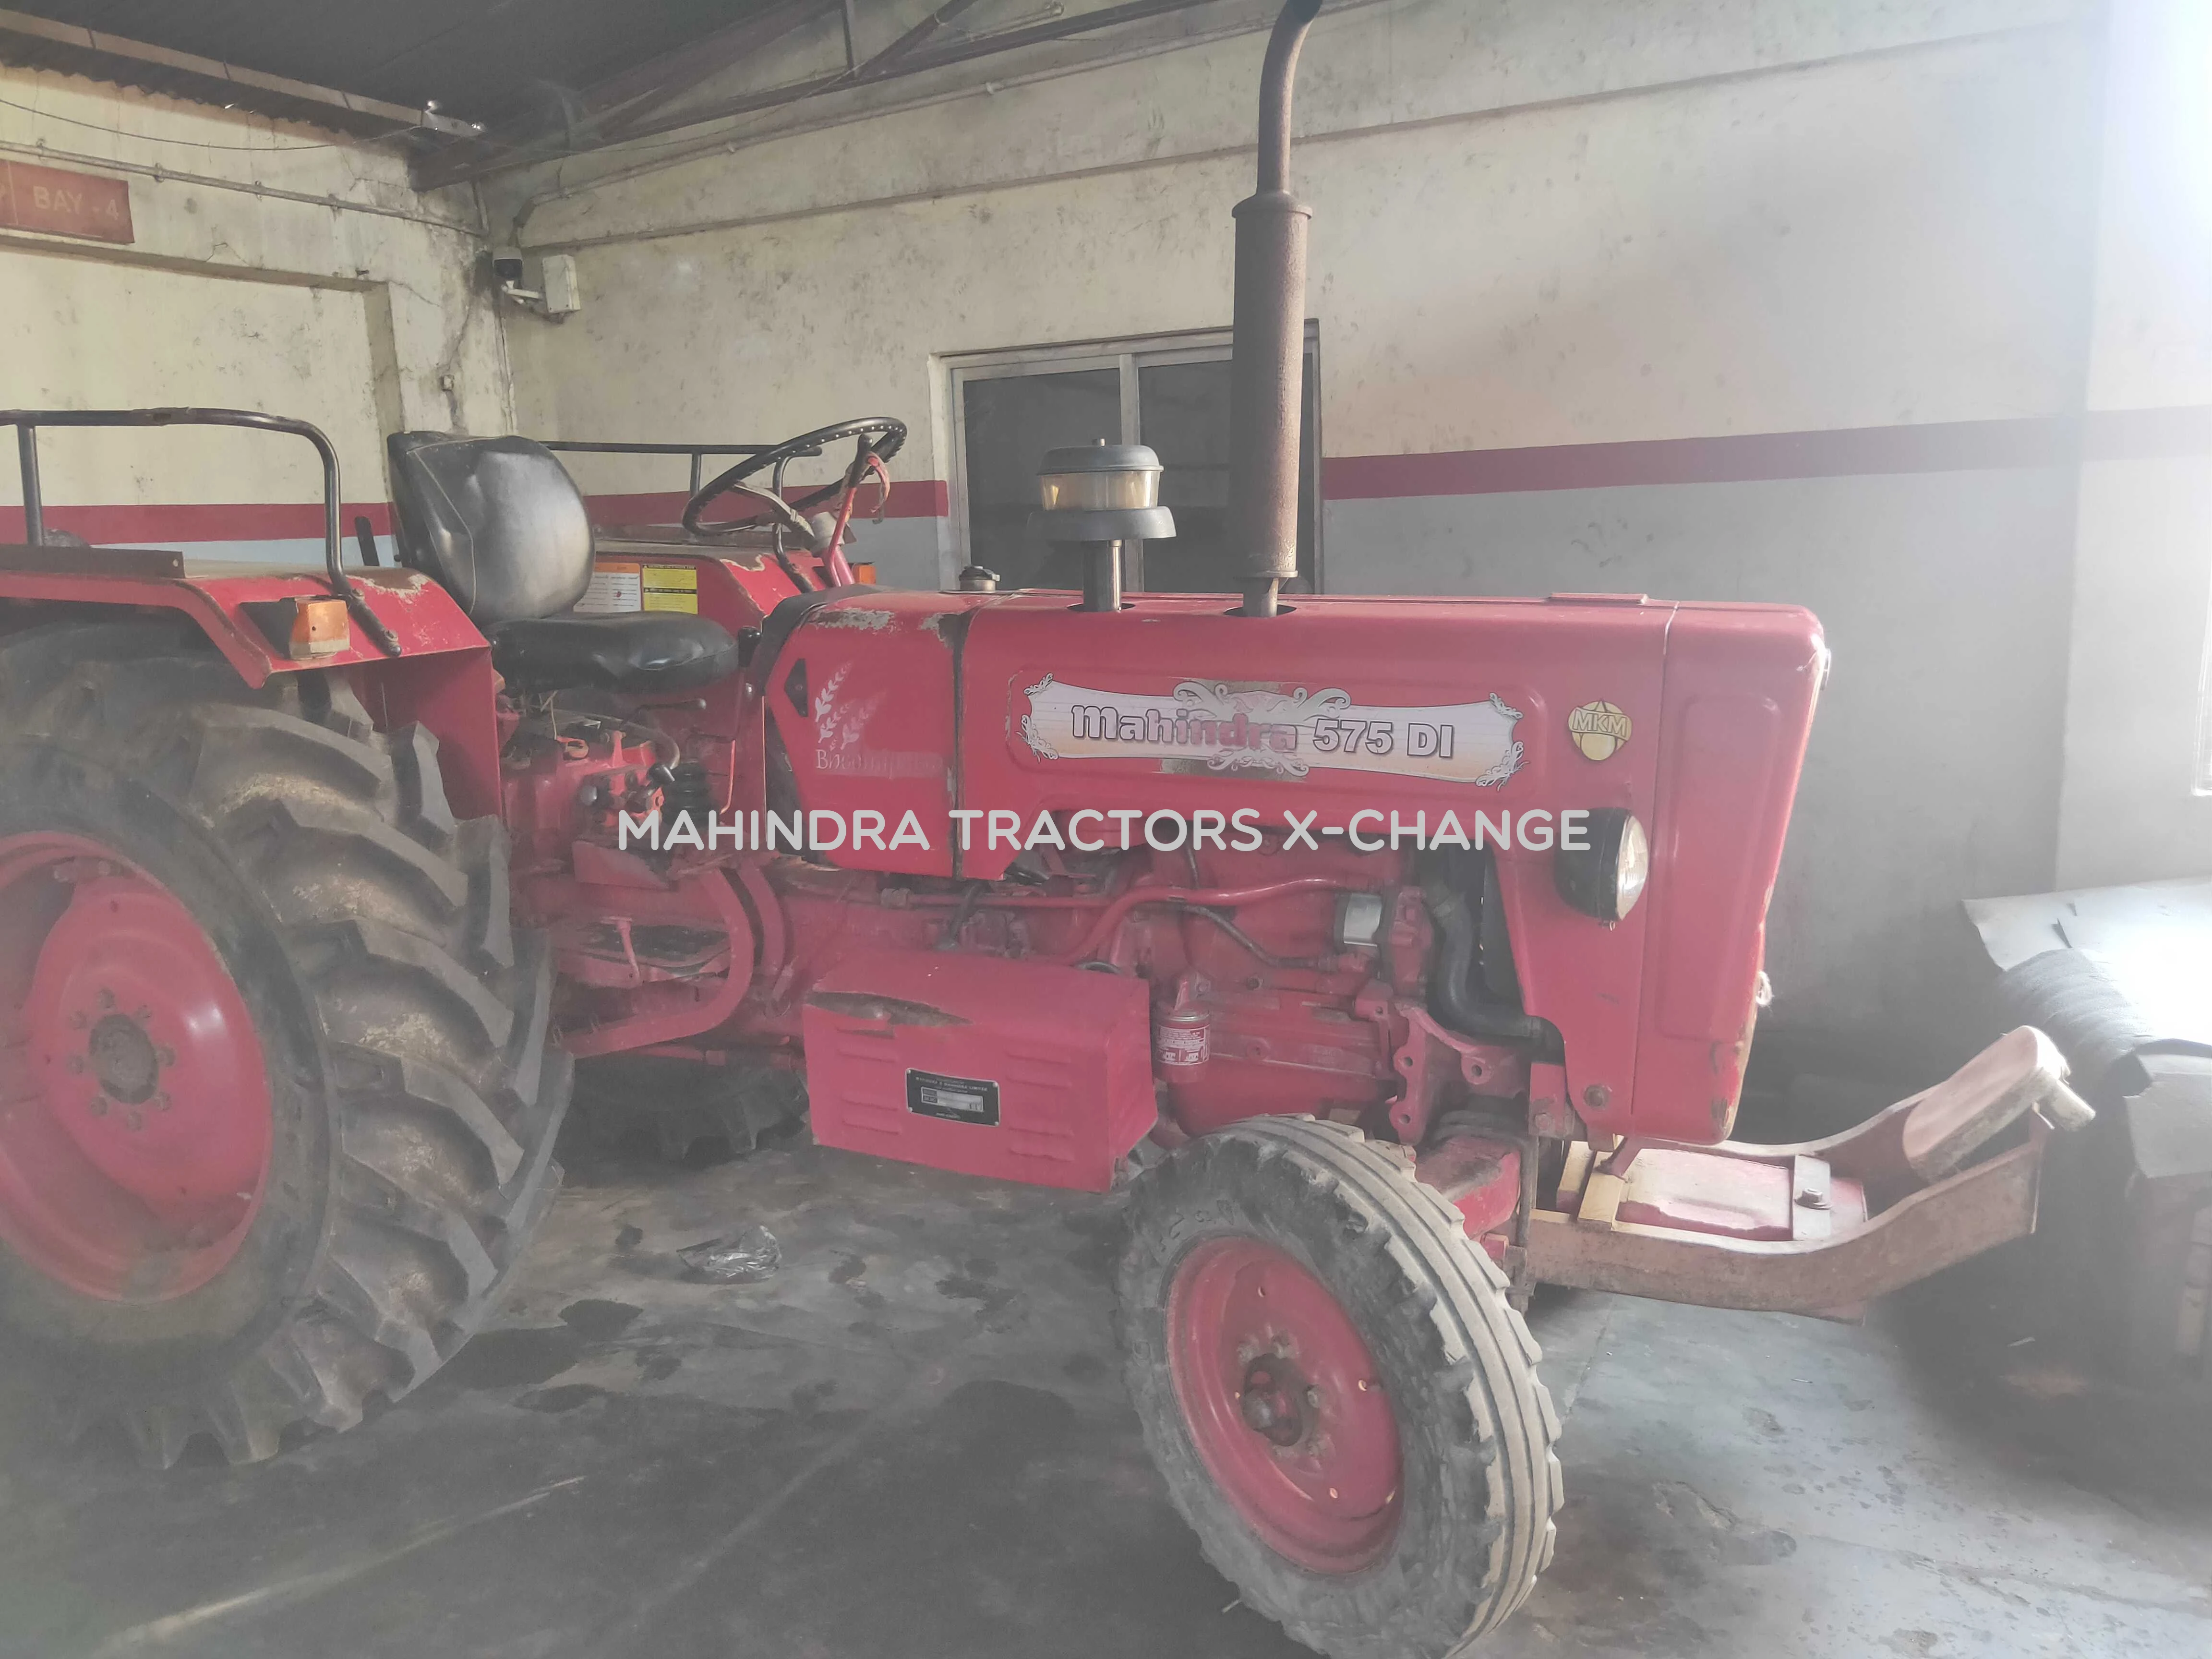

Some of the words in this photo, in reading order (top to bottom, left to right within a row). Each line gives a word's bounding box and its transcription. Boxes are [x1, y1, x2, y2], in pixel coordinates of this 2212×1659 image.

[33, 186, 83, 214] BAY
[106, 198, 119, 220] 4
[1312, 718, 1394, 754] 575
[1407, 722, 1454, 758] DI
[1572, 709, 1628, 738] MKM
